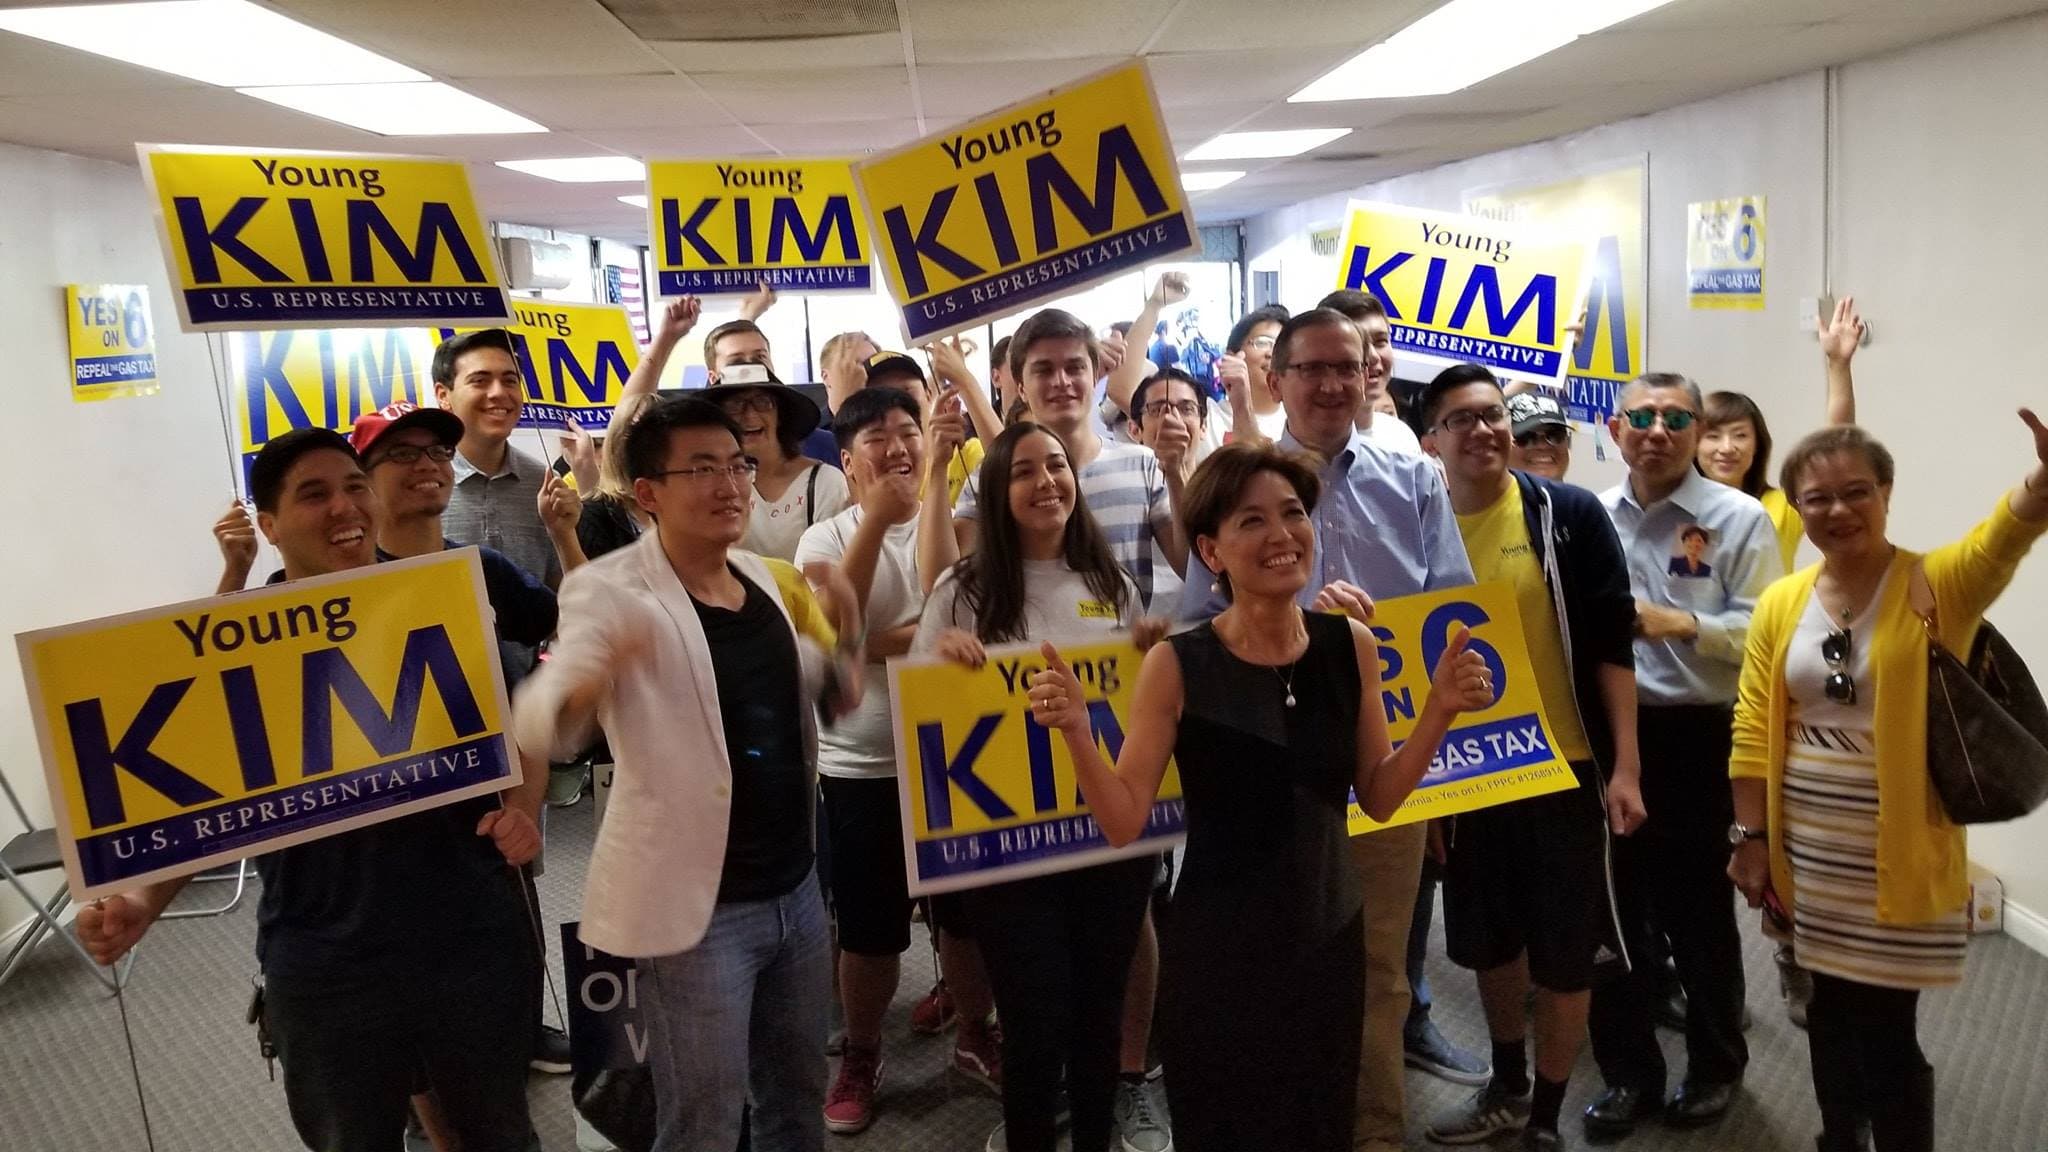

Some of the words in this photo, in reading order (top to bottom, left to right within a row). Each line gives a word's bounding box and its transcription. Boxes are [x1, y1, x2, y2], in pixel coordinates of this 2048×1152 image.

[941, 109, 1062, 170] Young
[252, 159, 385, 198] Young
[717, 164, 804, 193] Young
[661, 196, 862, 267] KIM
[883, 123, 1170, 299] KIM
[1733, 204, 1757, 262] 6
[173, 197, 488, 284] KIM
[1421, 222, 1512, 263] Young
[675, 273, 706, 287] U.S.
[714, 267, 856, 287] REPRESENTATIVE
[923, 296, 964, 320] U.S.
[973, 224, 1168, 305] REPRESENTATIVE
[1344, 245, 1557, 347] KIM
[1725, 273, 1743, 289] GAS
[1743, 272, 1761, 289] TAX
[78, 297, 118, 326] YES
[123, 292, 147, 348] 6
[212, 293, 262, 309] U.S.
[274, 291, 486, 308] REPRESENTATIVE
[515, 310, 572, 337] ung
[103, 330, 119, 347] ON
[77, 363, 112, 379] REPEAL
[119, 360, 138, 375] GAS
[138, 360, 155, 374] TAX
[241, 331, 418, 445] KIM
[519, 405, 615, 424] EPRESENTAT
[174, 596, 357, 658] Young
[996, 654, 1120, 698] Yong
[1421, 601, 1507, 713] 6
[64, 623, 488, 830] KIM
[1381, 686, 1416, 723] N
[1428, 738, 1485, 774] GAS
[1485, 725, 1547, 761] TAX
[113, 828, 181, 861] U.S.
[193, 748, 482, 840] REPRESENTATIVE
[943, 840, 988, 864] U.S.
[1000, 800, 1185, 853] REPRESETIV
